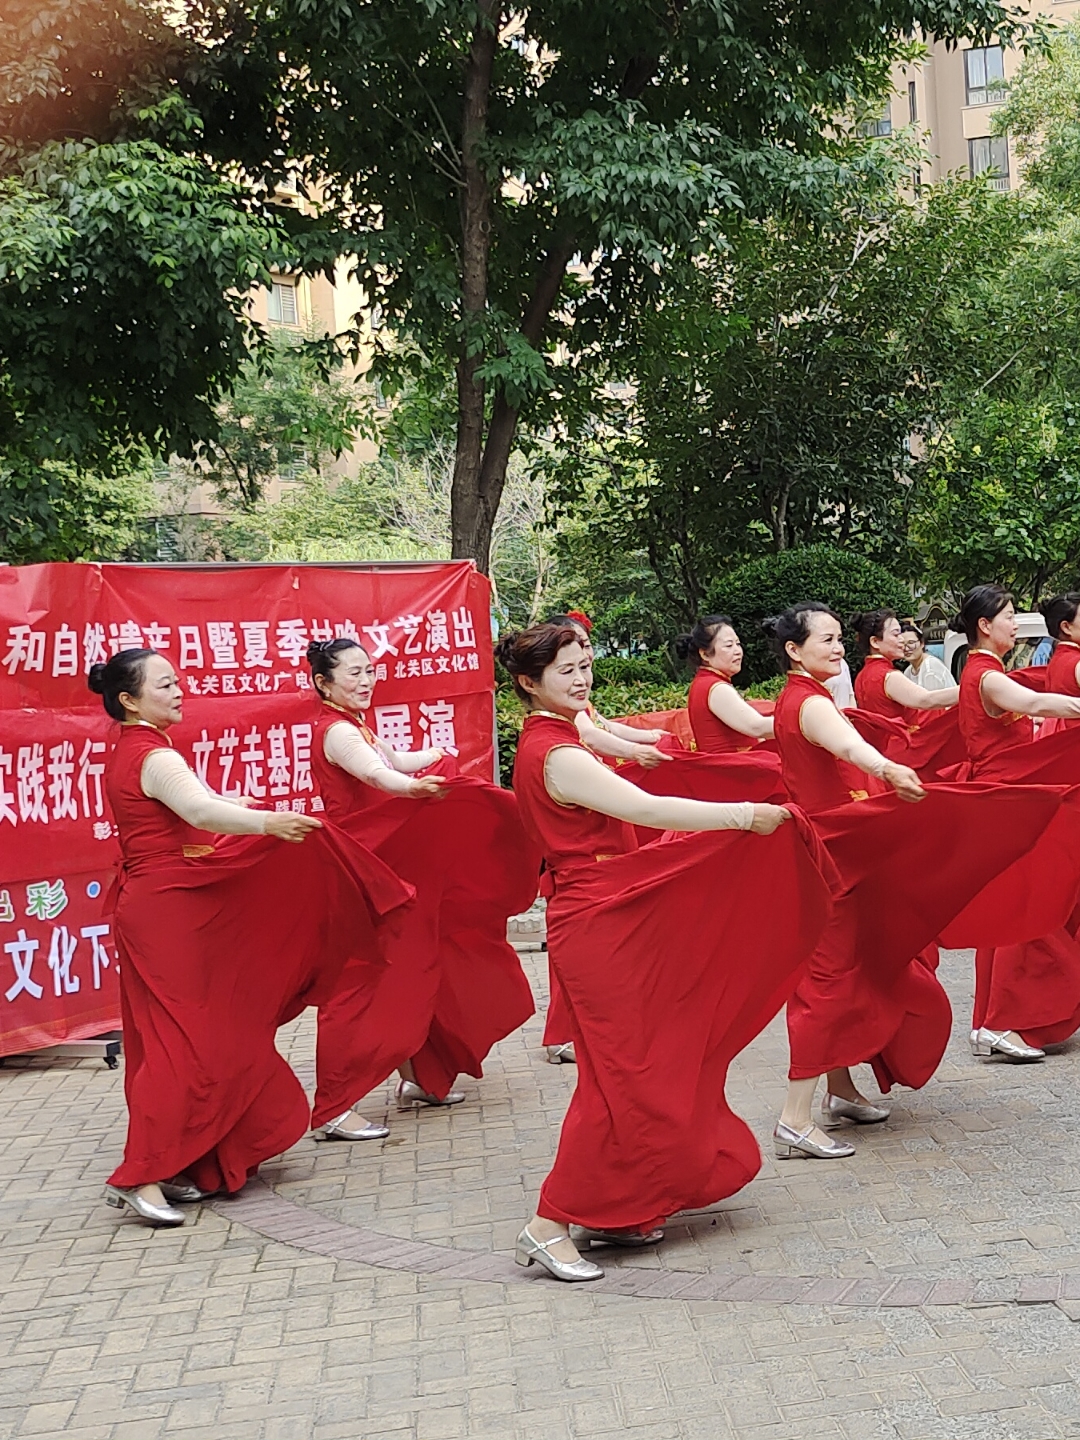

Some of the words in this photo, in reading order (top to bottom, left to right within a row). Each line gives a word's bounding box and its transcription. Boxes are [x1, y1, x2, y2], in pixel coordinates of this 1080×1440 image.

[394, 653, 480, 680] 北关区文化馆
[0, 739, 117, 827] 践我行
[192, 723, 315, 798] 文艺走基层
[4, 924, 121, 1002] 文化下
